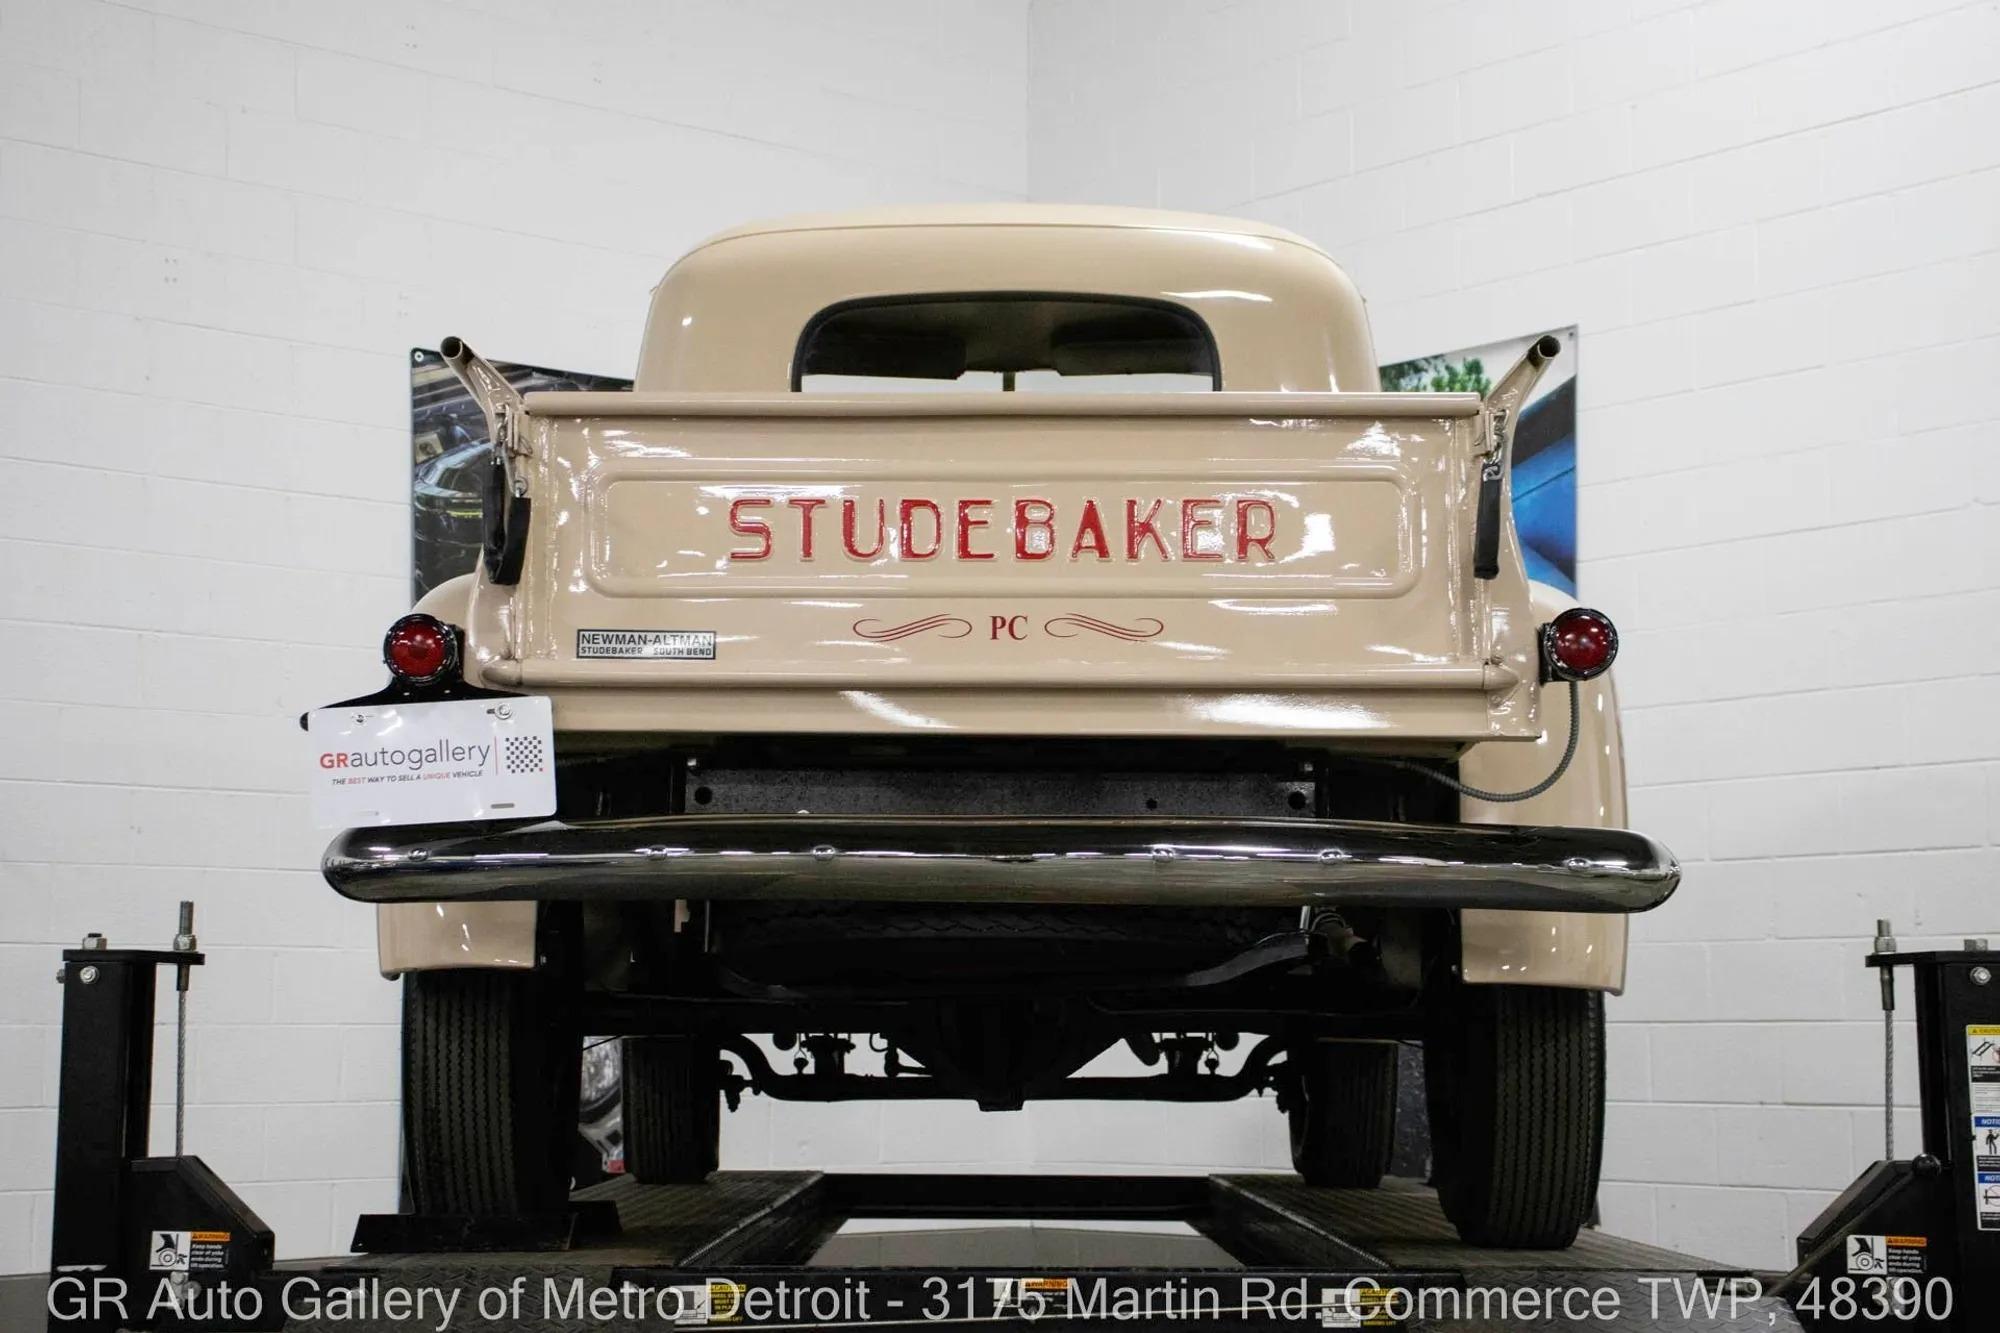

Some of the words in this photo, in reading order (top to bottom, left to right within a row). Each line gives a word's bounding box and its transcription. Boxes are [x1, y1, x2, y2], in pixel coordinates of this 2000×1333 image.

[729, 498, 1277, 560] STUDEBAKER
[990, 614, 1028, 640] PC
[581, 633, 712, 647] NEWMAN-ALTMAN
[580, 646, 643, 655] STUDEBAKER
[653, 647, 684, 656] SOUTH
[686, 647, 712, 656] BEND
[332, 777, 346, 785] THE
[347, 776, 366, 784] BEST
[367, 775, 384, 783] WAY
[386, 774, 397, 782] TO
[398, 773, 413, 781] SELL
[423, 771, 450, 780] UNIQUE
[452, 769, 483, 778] VEHICLE
